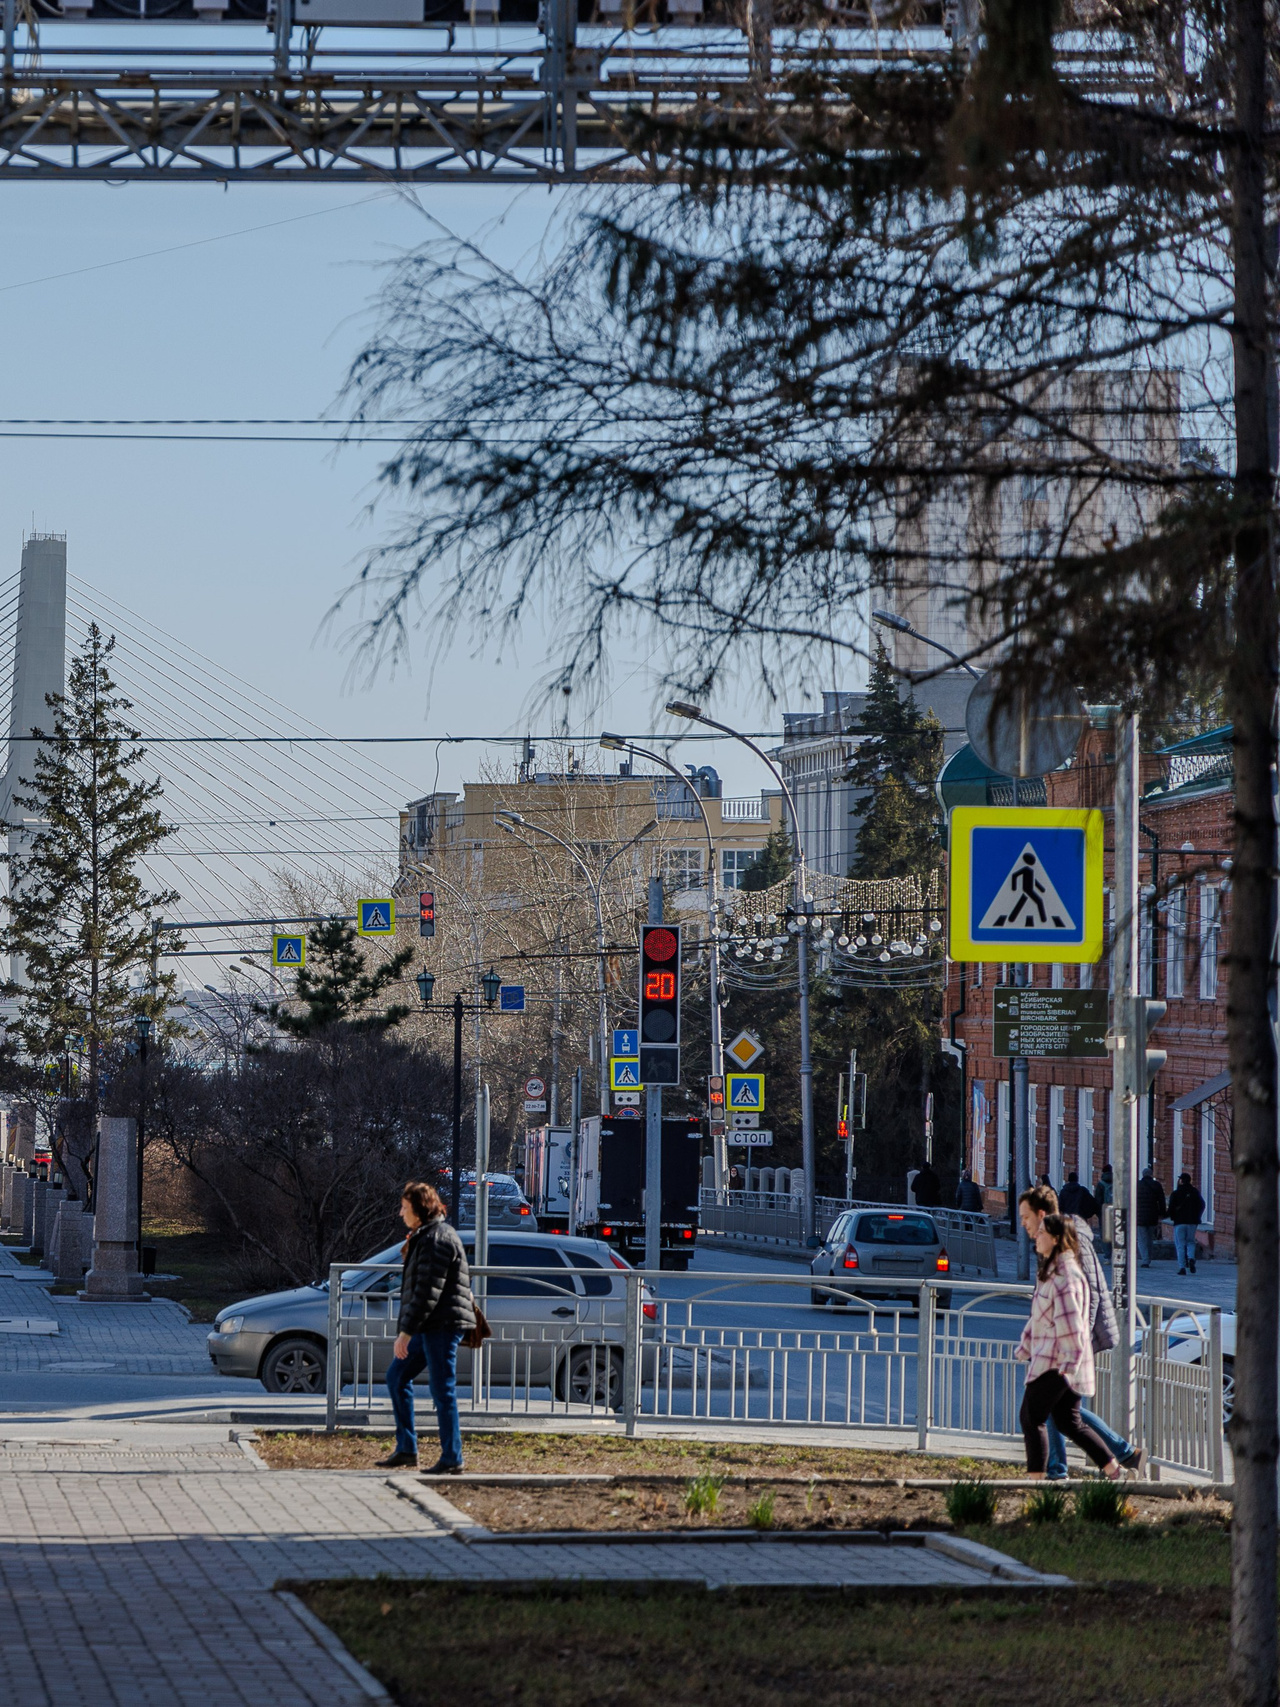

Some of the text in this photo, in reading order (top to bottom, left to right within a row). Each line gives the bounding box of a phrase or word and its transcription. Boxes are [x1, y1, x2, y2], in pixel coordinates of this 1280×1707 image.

[421, 909, 434, 920] 44
[646, 973, 675, 1000] 20
[734, 1133, 767, 1143] СТОП
